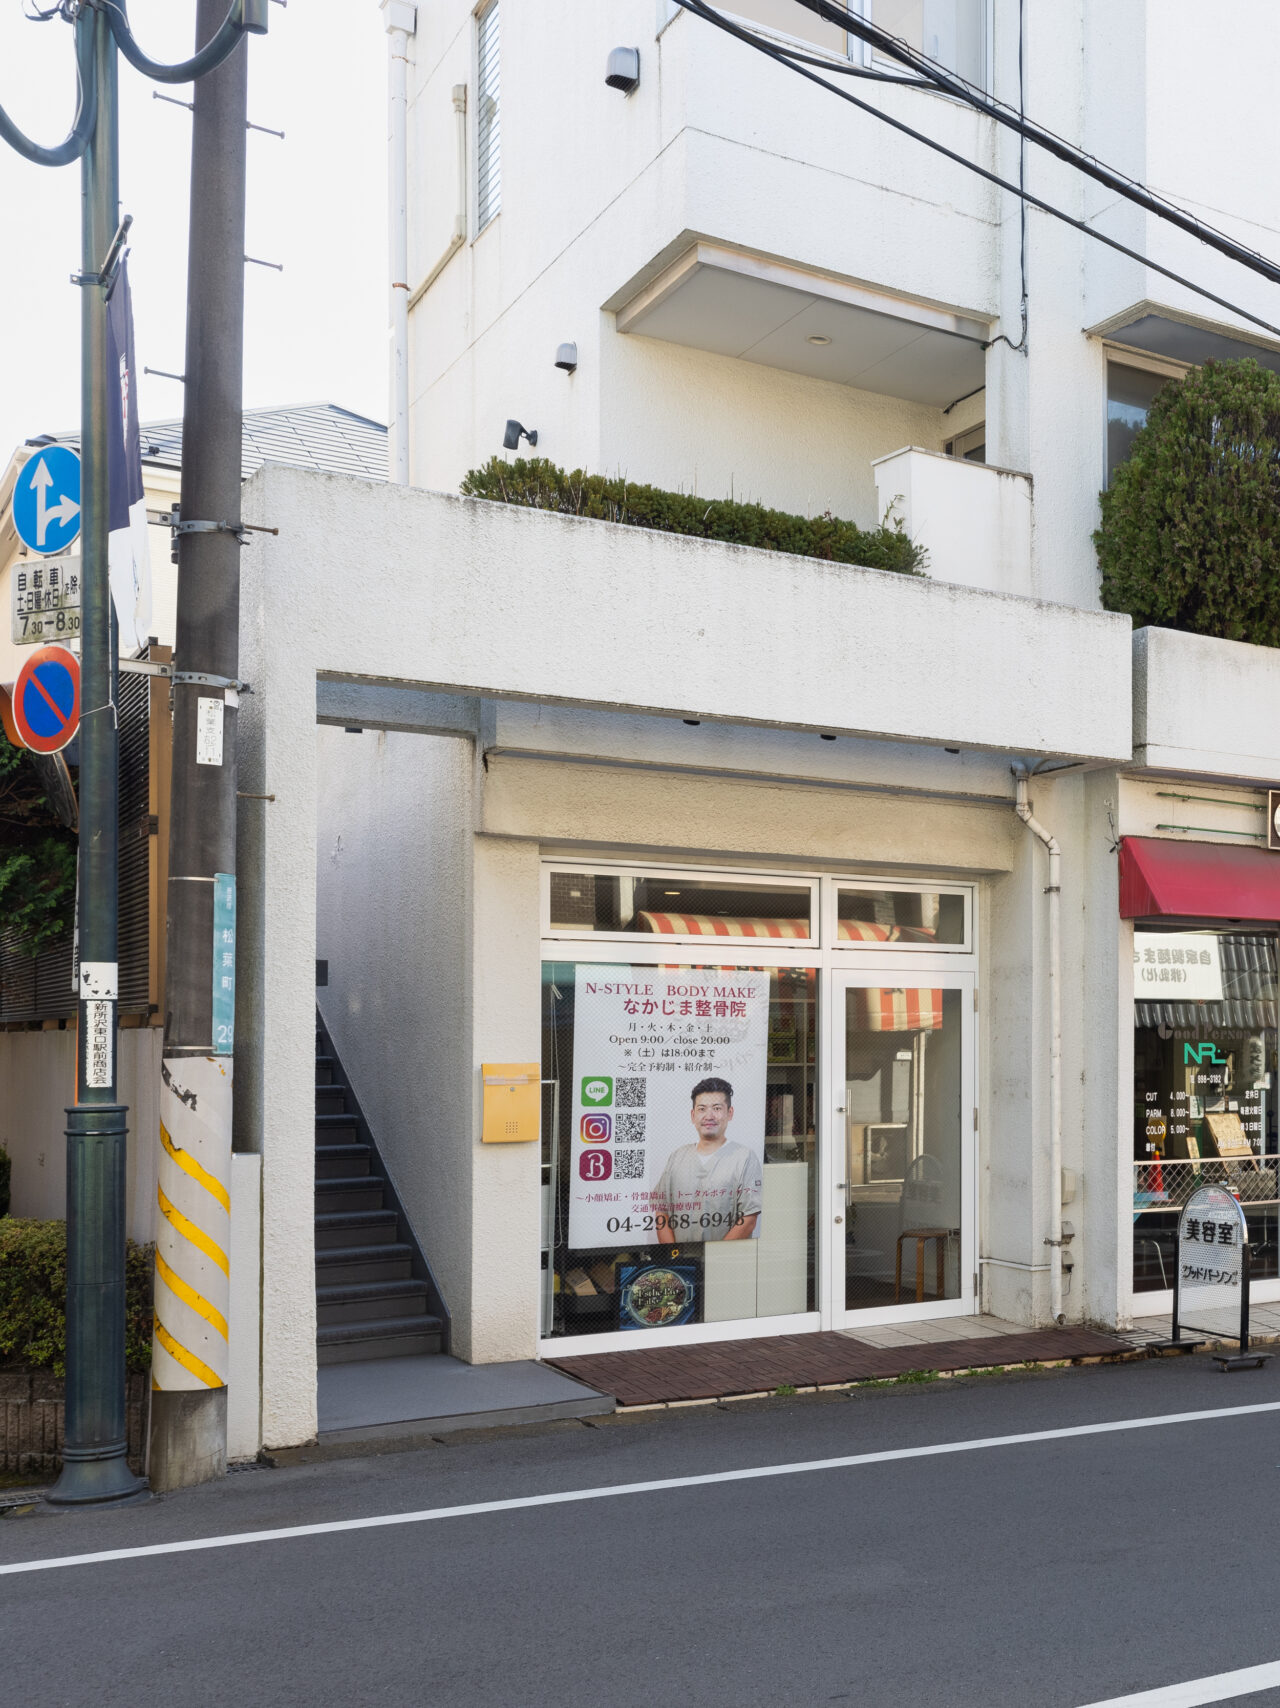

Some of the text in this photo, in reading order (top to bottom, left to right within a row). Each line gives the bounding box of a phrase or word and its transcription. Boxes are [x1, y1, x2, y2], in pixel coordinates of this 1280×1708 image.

[222, 928, 233, 990] 松葉町
[585, 983, 756, 999] N-STYLE BODY MAKE
[624, 998, 747, 1017] なかじま整骨院
[93, 1002, 108, 1085] 新所沢東口駅前商店会
[609, 1035, 638, 1045] Open
[700, 1036, 730, 1045] 20:00
[1146, 1092, 1158, 1101] CUT
[1245, 1090, 1259, 1099] 定休日
[1146, 1108, 1162, 1118] PARM
[1146, 1125, 1166, 1135] COLOR
[606, 1211, 745, 1233] 04-2968-6948
[1186, 1218, 1233, 1245] 美容室
[1183, 1266, 1232, 1284] グッドパーソン
